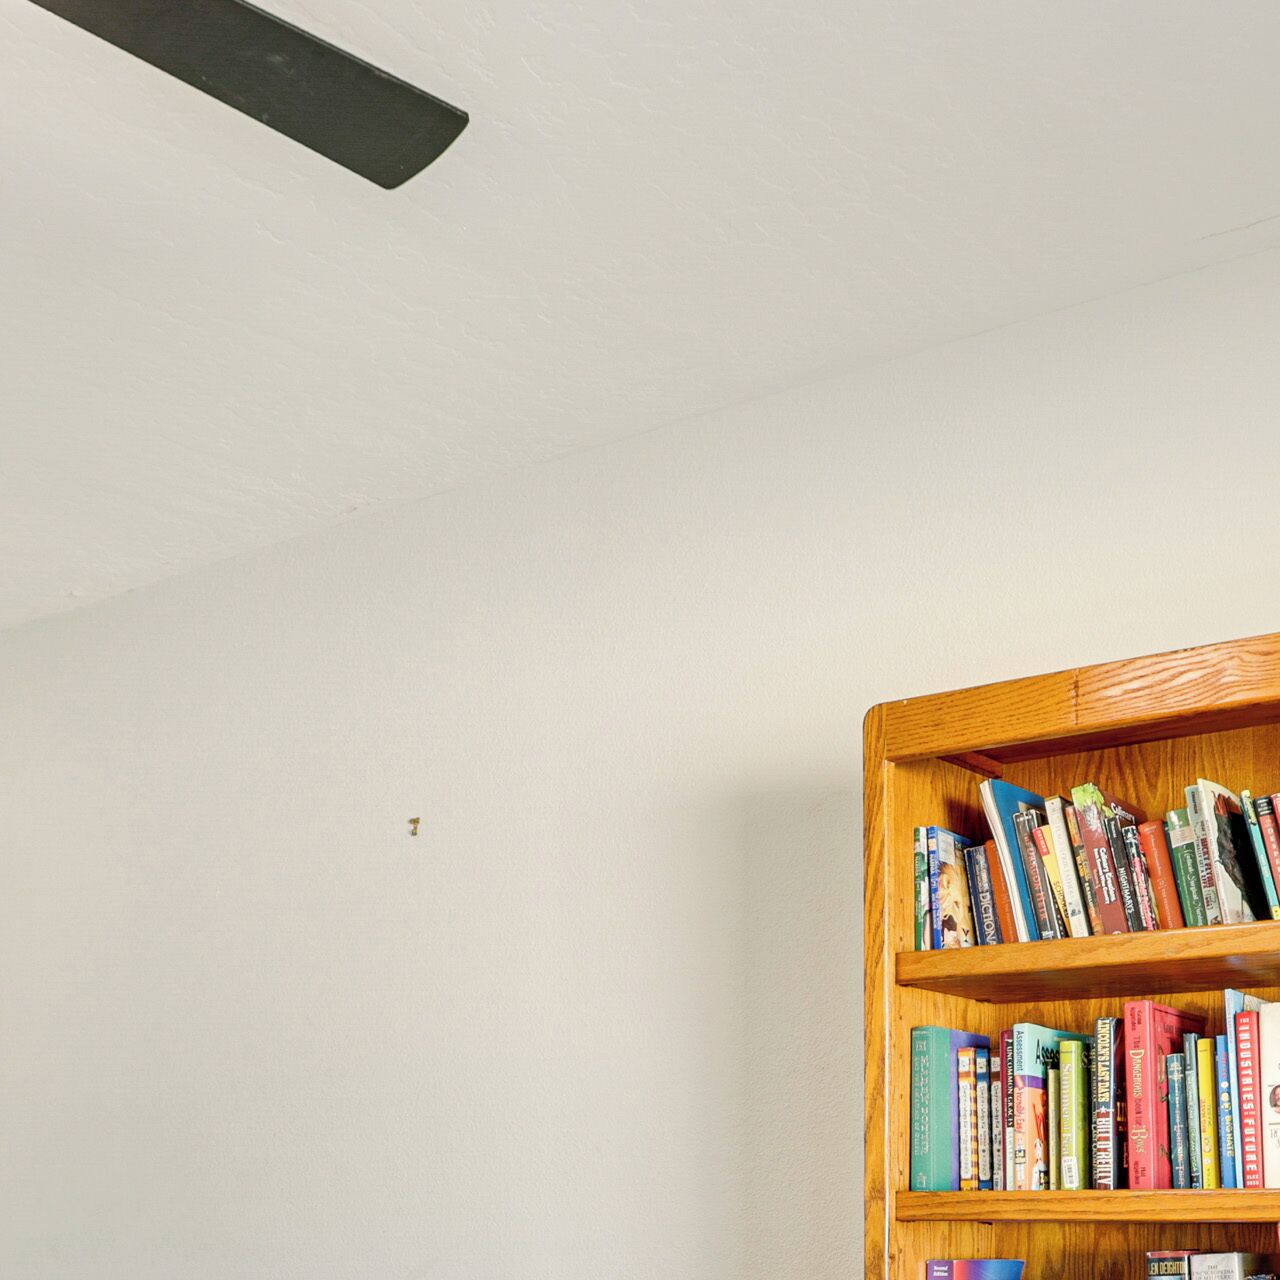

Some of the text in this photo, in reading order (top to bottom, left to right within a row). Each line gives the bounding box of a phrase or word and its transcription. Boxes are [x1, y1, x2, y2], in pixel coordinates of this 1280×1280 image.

[1097, 1019, 1110, 1102] LINCOLN'S LAST DAYS
[1097, 1118, 1112, 1184] BILL O'REILLY
